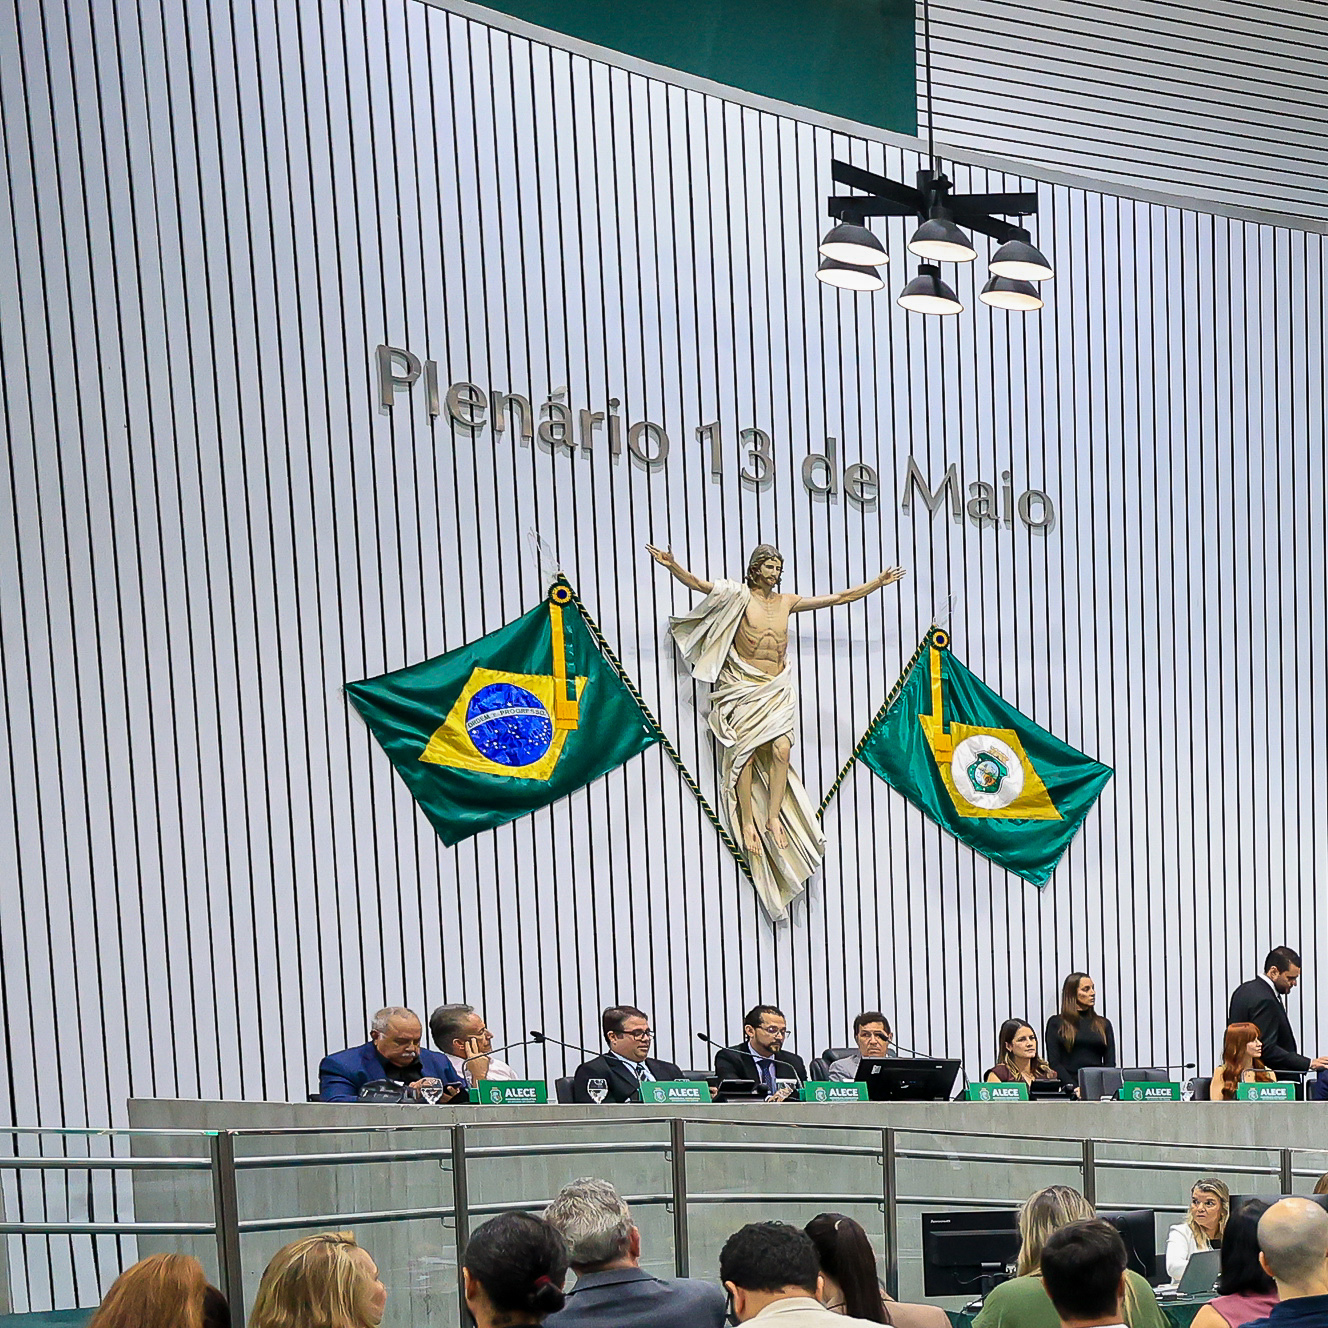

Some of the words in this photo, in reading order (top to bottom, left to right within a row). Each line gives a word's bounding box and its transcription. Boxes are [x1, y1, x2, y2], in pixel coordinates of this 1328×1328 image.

[375, 344, 670, 470] Plenário
[696, 420, 776, 489] 13
[802, 437, 879, 509] de
[902, 455, 1055, 532] Maio
[467, 714, 491, 729] ORDEM
[499, 708, 547, 717] PROGRESSO
[505, 1088, 537, 1098] ALECE
[668, 1088, 700, 1097] ALECE
[829, 1088, 859, 1097] ALECE
[992, 1088, 1020, 1097] ALECE
[1144, 1088, 1172, 1097] ALECE
[1260, 1088, 1287, 1097] ALECE
